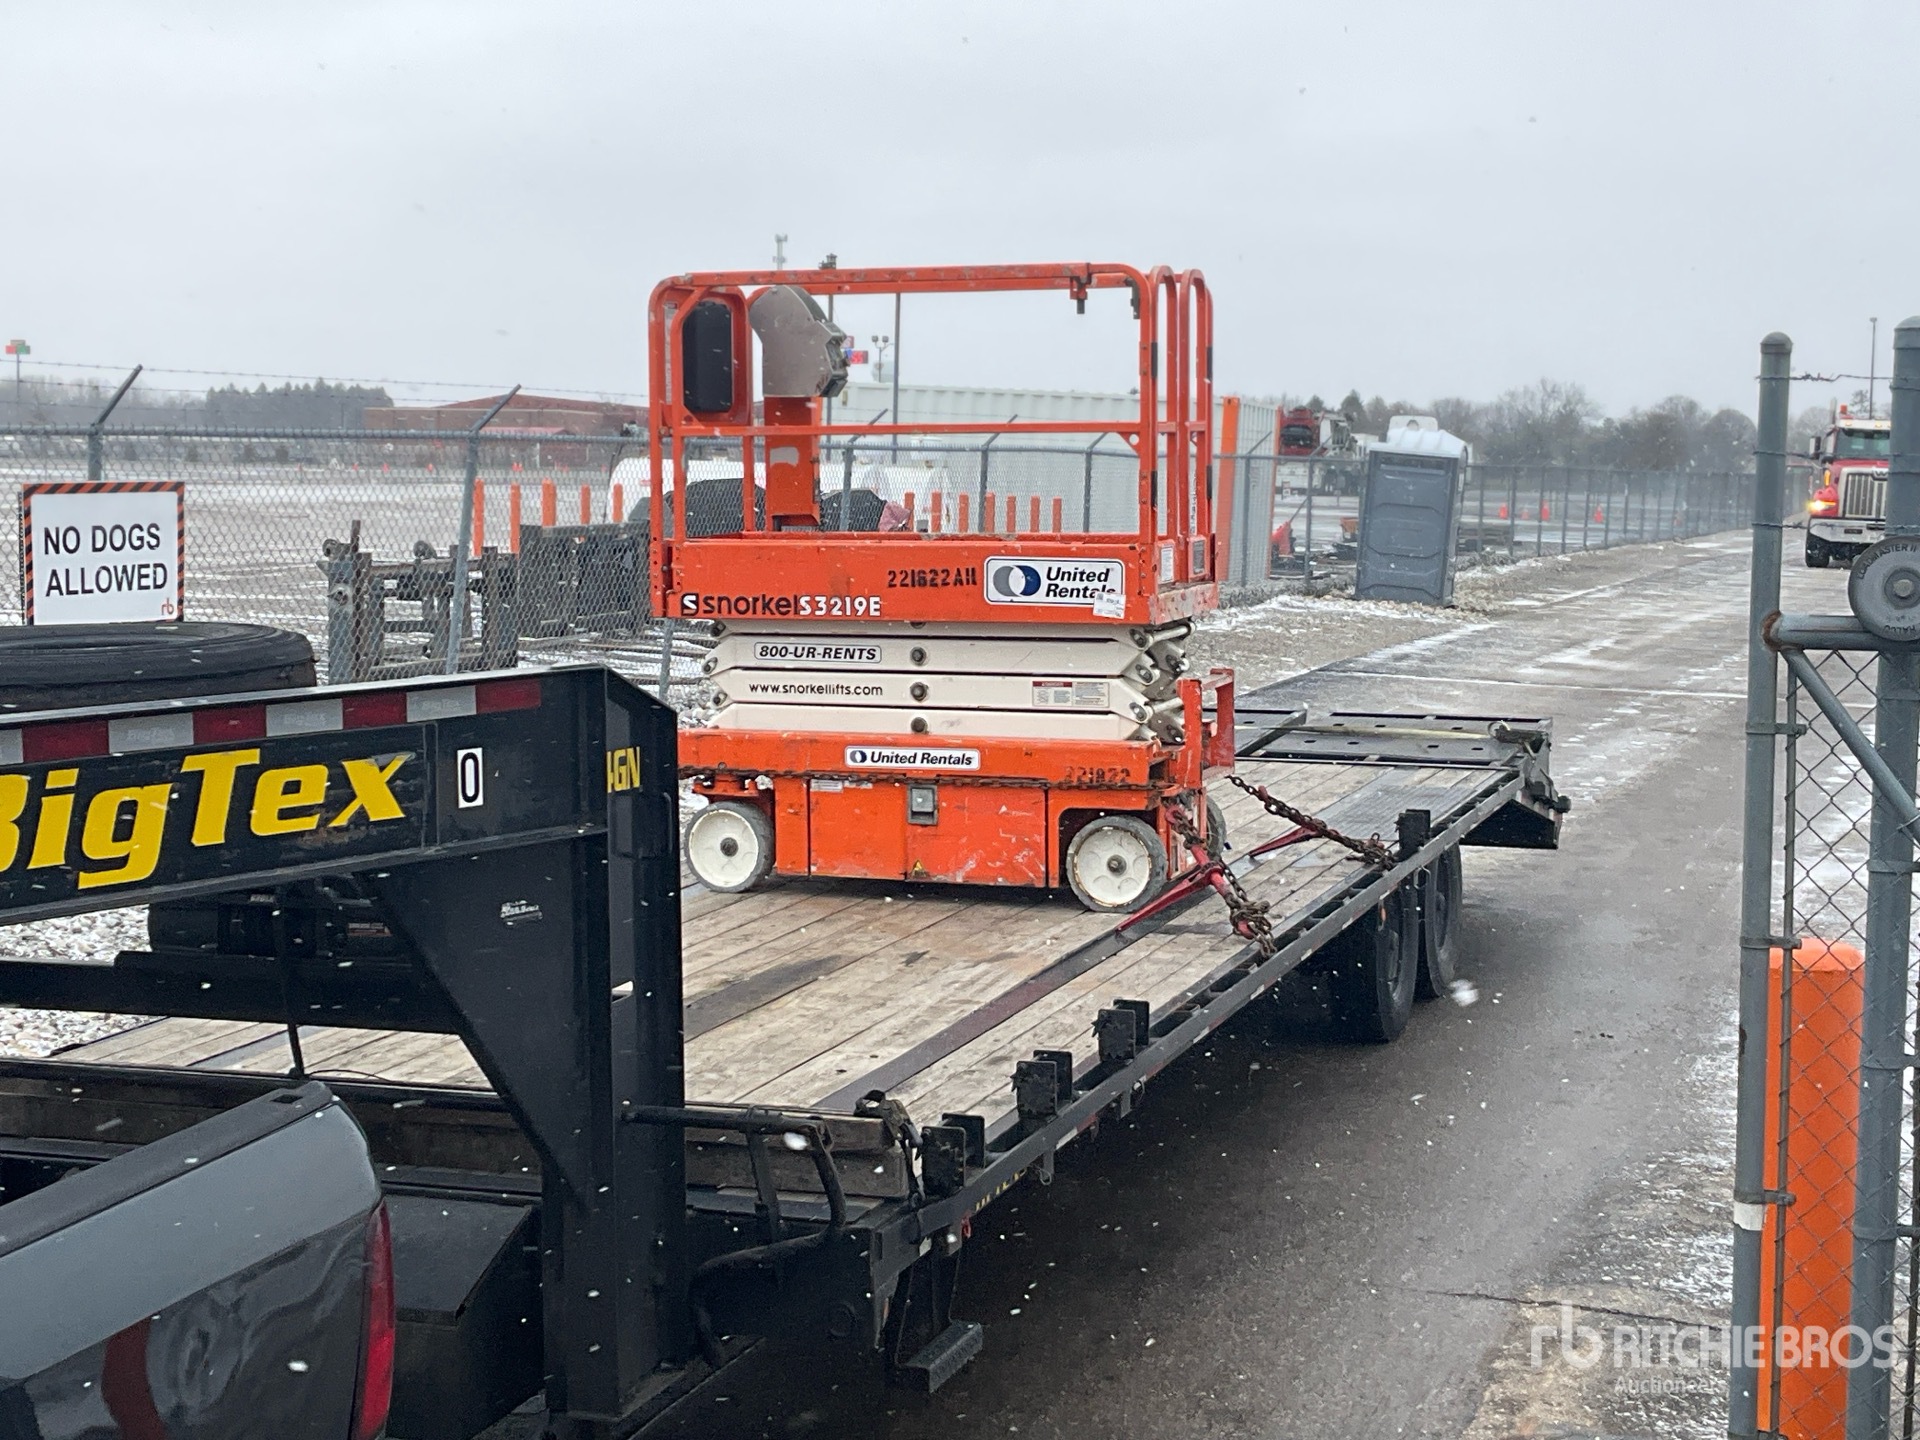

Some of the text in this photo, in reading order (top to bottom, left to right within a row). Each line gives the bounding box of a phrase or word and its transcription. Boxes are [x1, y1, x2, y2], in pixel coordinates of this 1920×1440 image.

[44, 523, 161, 555] NO DOGS
[45, 563, 168, 597] ALLOWED
[1046, 567, 1111, 583] United
[702, 594, 799, 616] snorkel
[799, 596, 881, 616] S3219E
[758, 645, 877, 661] 800-UR-RENTS
[749, 683, 884, 697] www.snorkellifts.com
[870, 750, 973, 766] United Rentals
[460, 752, 480, 803] 0
